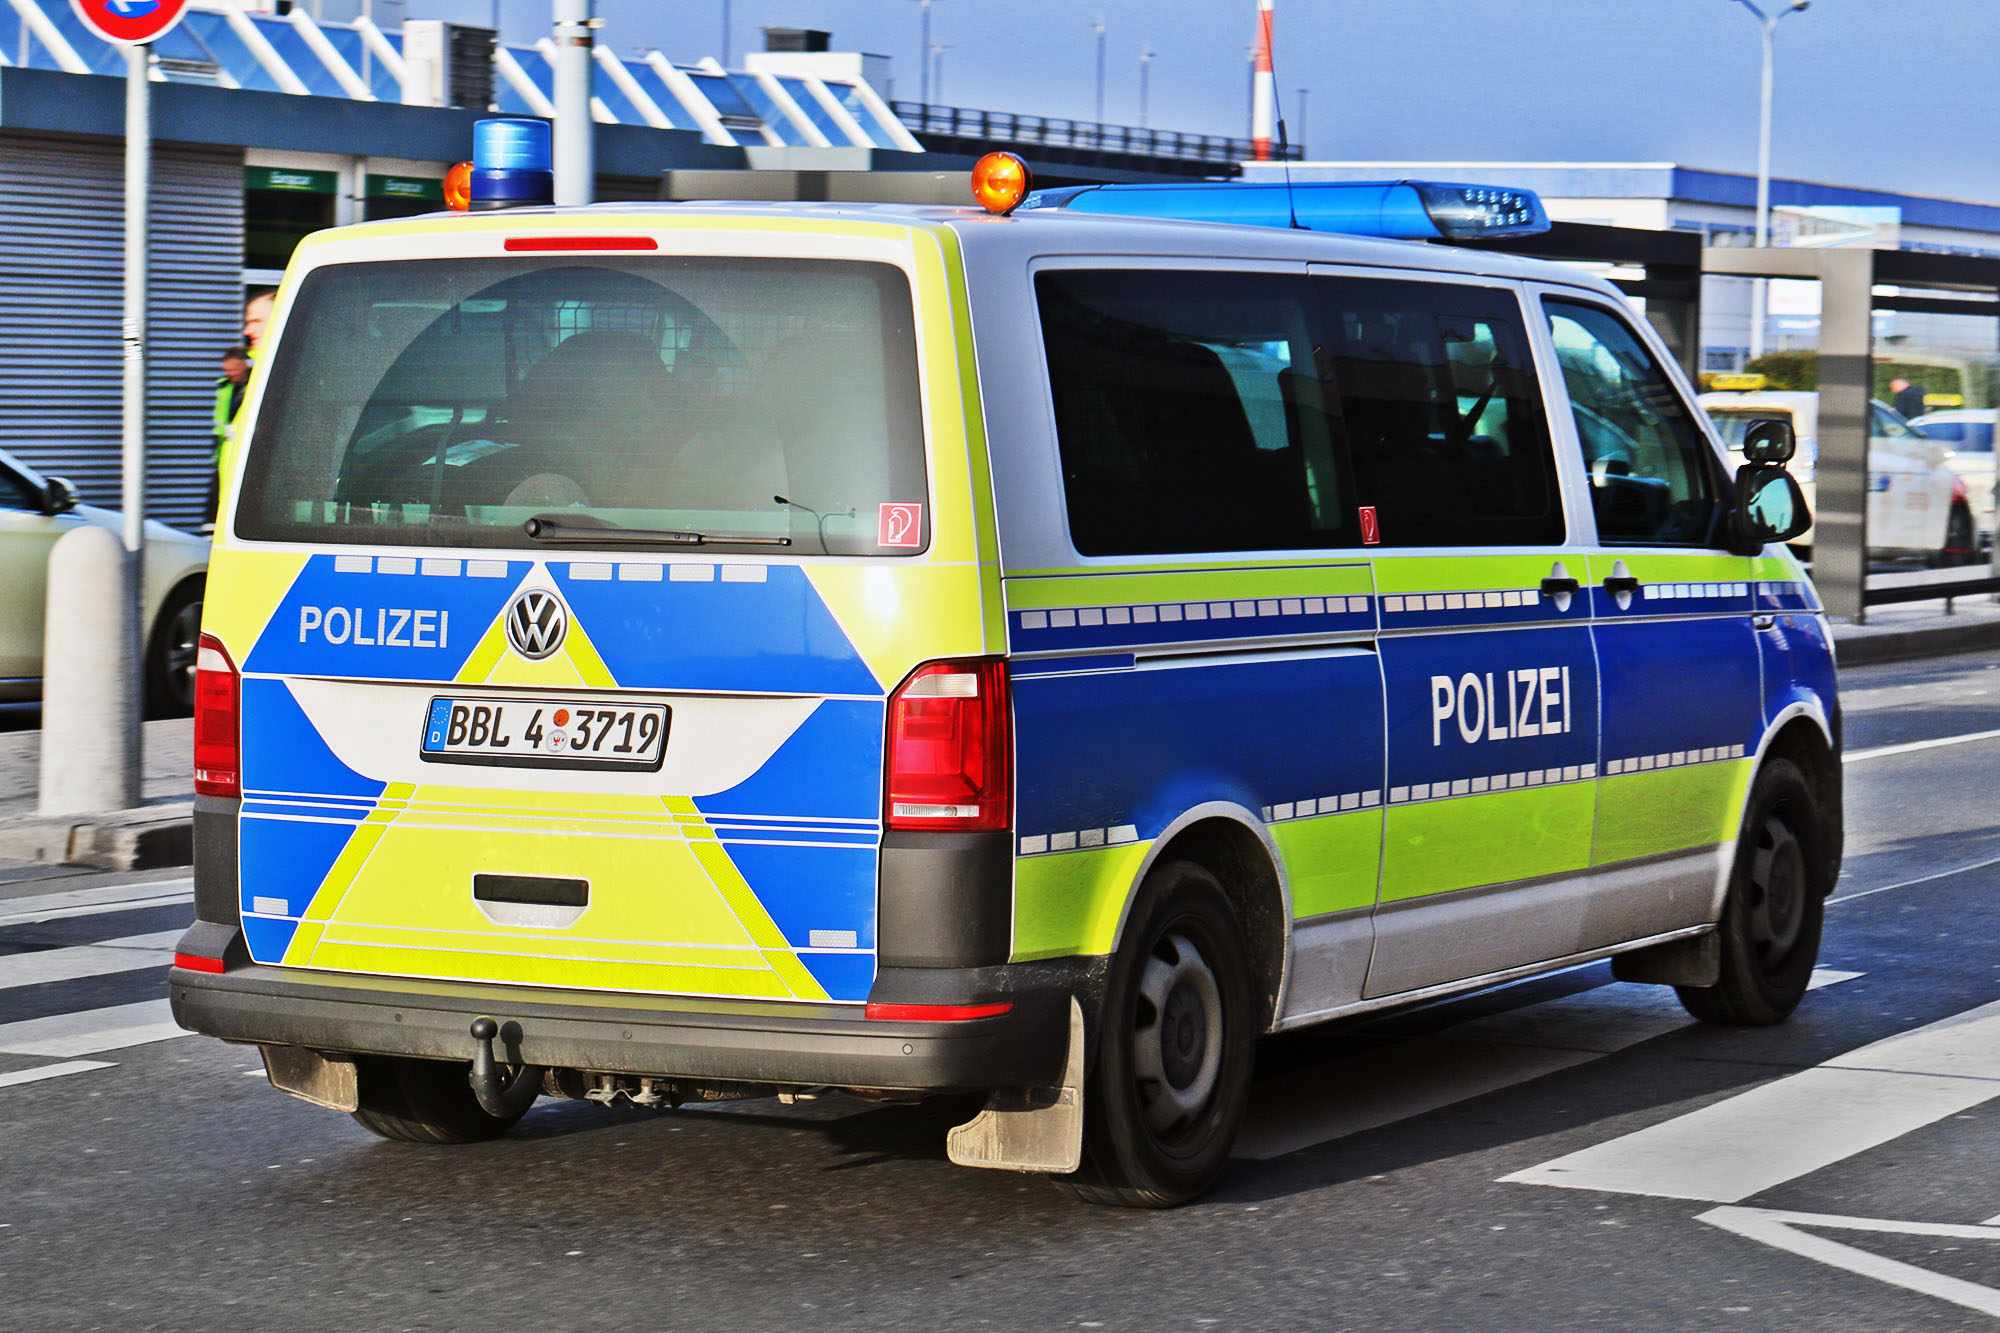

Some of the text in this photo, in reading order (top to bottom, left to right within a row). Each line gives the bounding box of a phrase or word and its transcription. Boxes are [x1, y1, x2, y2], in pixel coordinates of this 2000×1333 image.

[299, 605, 449, 649] POLIZEI
[431, 705, 660, 754] D BBL 4 3719
[1431, 665, 1571, 747] POLIZEI
